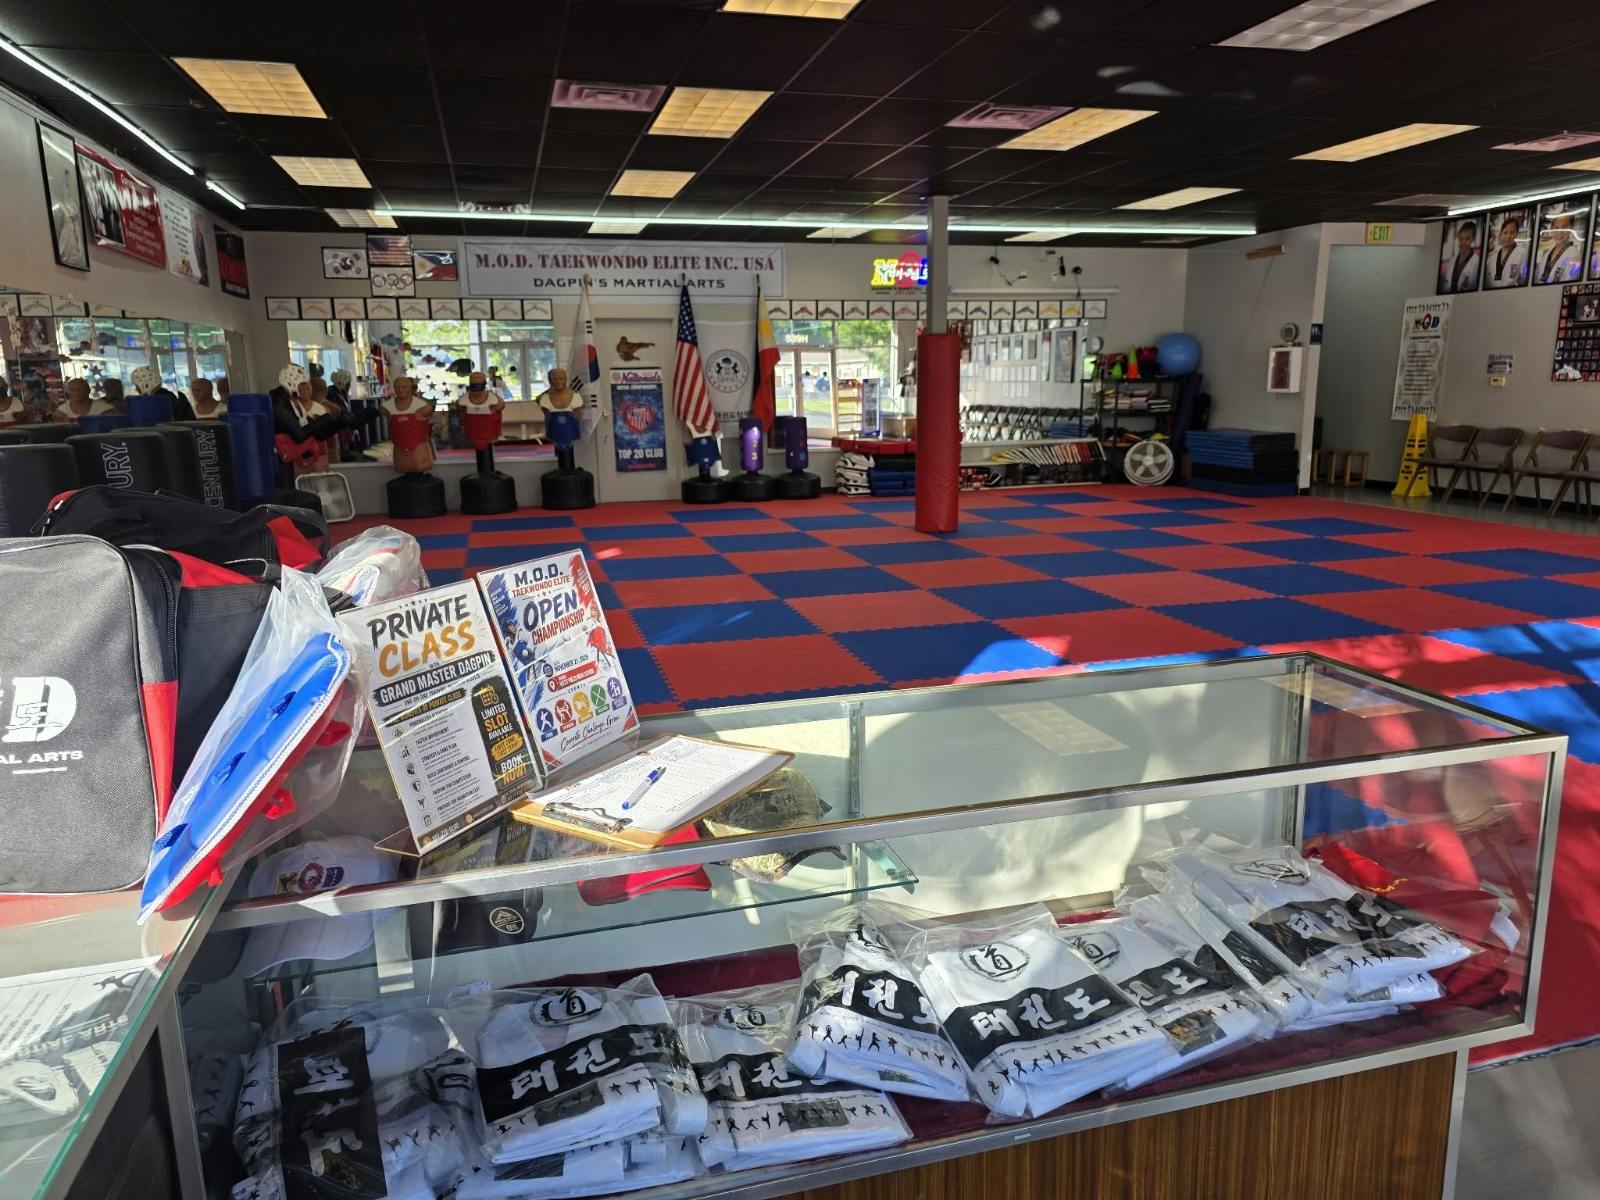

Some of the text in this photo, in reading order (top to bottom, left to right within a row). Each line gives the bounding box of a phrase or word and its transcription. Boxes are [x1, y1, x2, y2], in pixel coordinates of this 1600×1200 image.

[1373, 226, 1390, 241] EXIT
[475, 254, 775, 271] M.O.D. TAEKWONDO ELITE INC. USA
[533, 277, 726, 289] DAGPIN'S MARTIAL ARTS
[618, 447, 664, 460] TOP 20 CLUB
[513, 563, 564, 588] M.O.D.
[511, 581, 553, 598] TAEKWONDO
[553, 575, 571, 587] ELITE
[523, 589, 578, 632] OPEN
[367, 594, 471, 650] PRIVATE
[531, 607, 585, 646] CHAMPIONSHIP
[378, 620, 477, 678] CLASS
[380, 653, 493, 704] GRAND MASTER DAGPIN
[447, 690, 462, 702] CLASS
[481, 703, 506, 720] LIMITED
[484, 711, 510, 732] SLOT
[488, 723, 514, 741] AVAILABLE
[27, 750, 84, 763] ARTS
[500, 753, 523, 773] BOOK
[502, 766, 528, 787] NOW!
